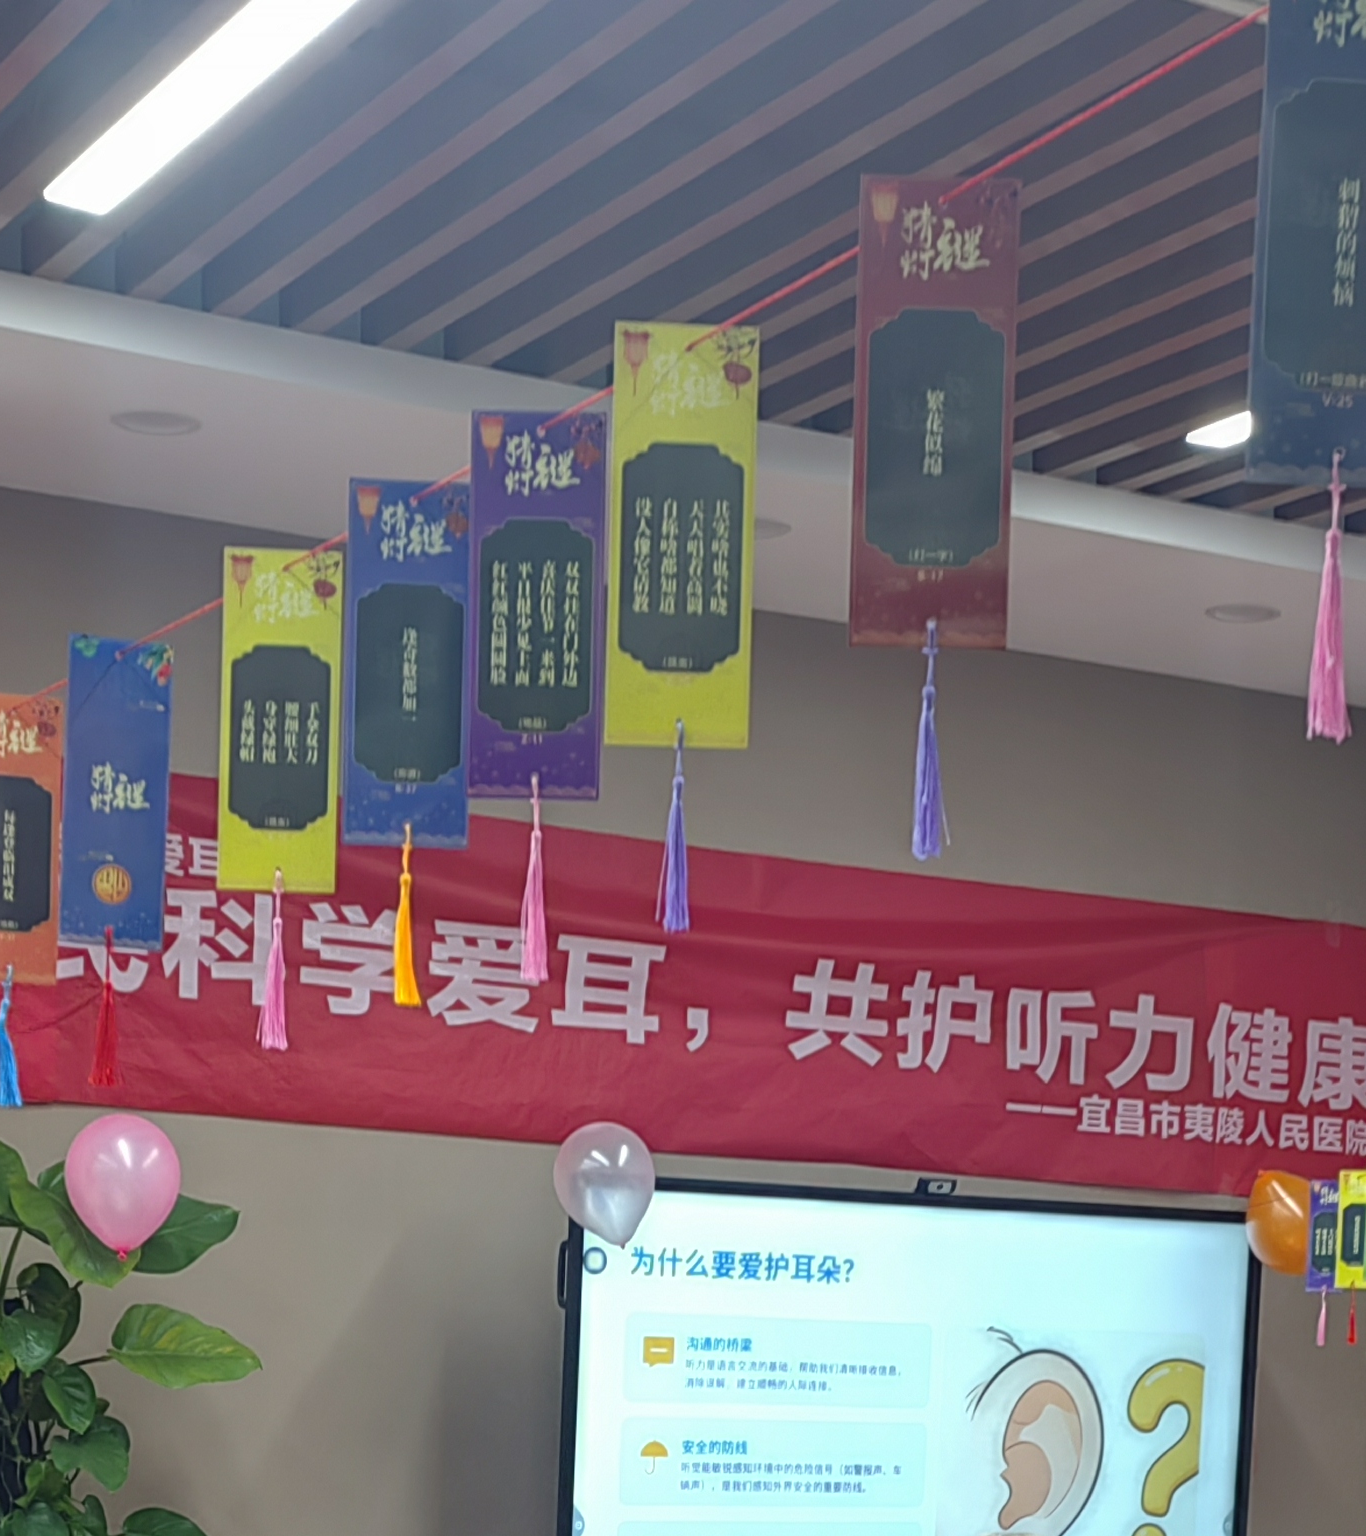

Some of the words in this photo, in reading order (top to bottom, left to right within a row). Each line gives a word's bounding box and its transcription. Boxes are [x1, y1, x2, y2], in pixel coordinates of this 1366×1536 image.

[631, 1246, 855, 1284] 为什么要爱护耳朵?
[686, 1337, 753, 1352] 沟通的桥梁
[681, 1440, 748, 1455] 安全的防线
